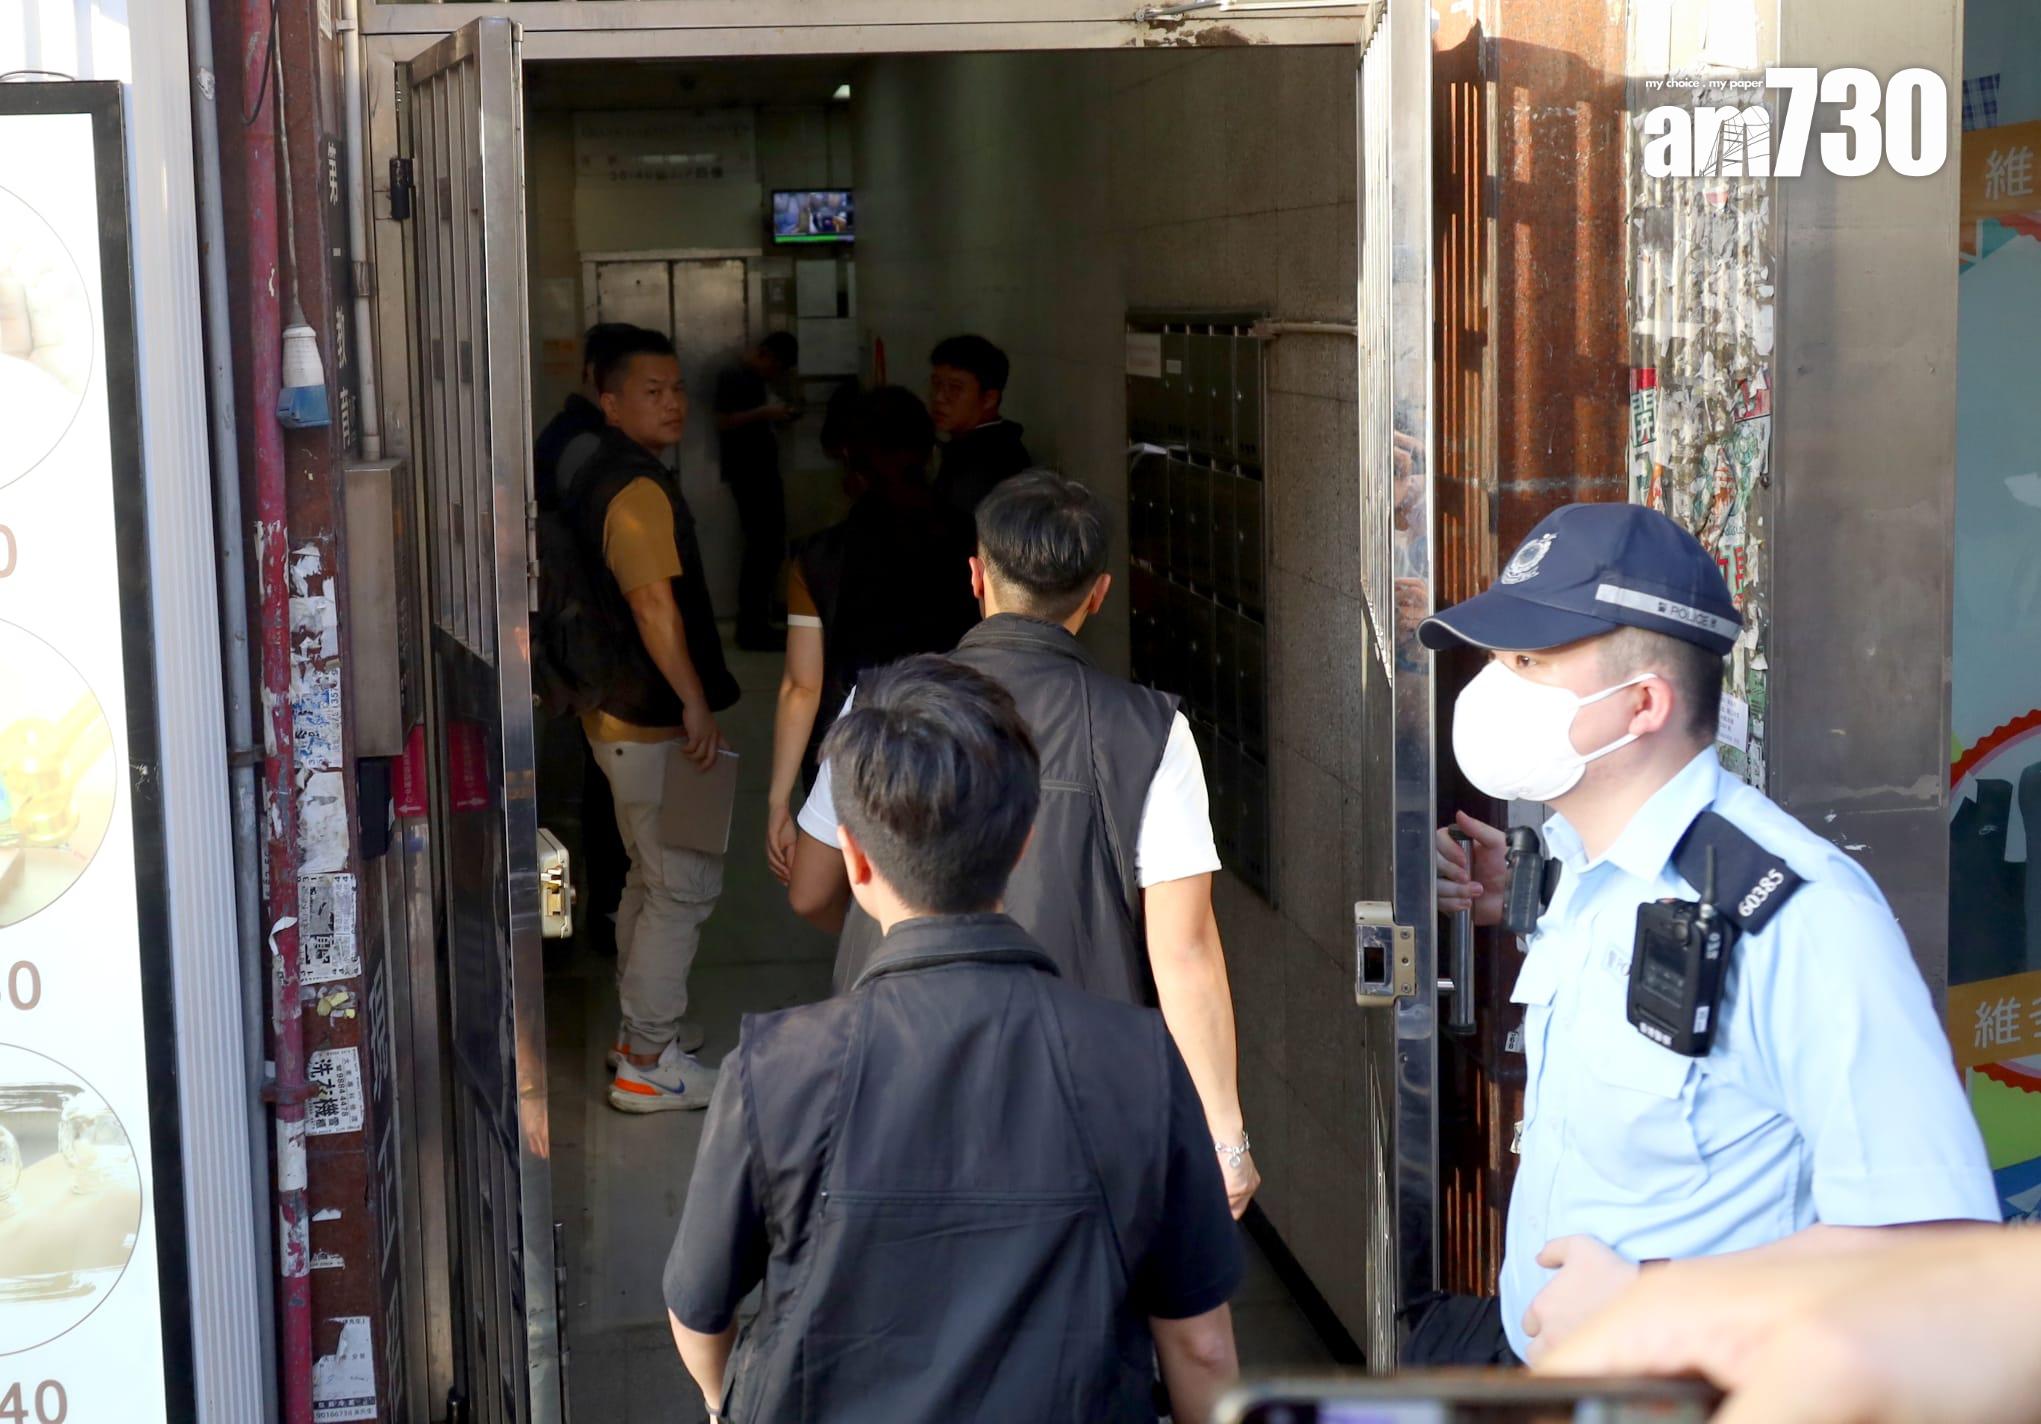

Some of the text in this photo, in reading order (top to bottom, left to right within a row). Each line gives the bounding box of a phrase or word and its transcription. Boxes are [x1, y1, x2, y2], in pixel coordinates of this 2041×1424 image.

[1984, 145, 2034, 200] 維
[1671, 605, 1708, 627] POLICE
[1738, 868, 1784, 917] 60385
[0, 960, 41, 1011] 0
[0, 1379, 67, 1424] 40
